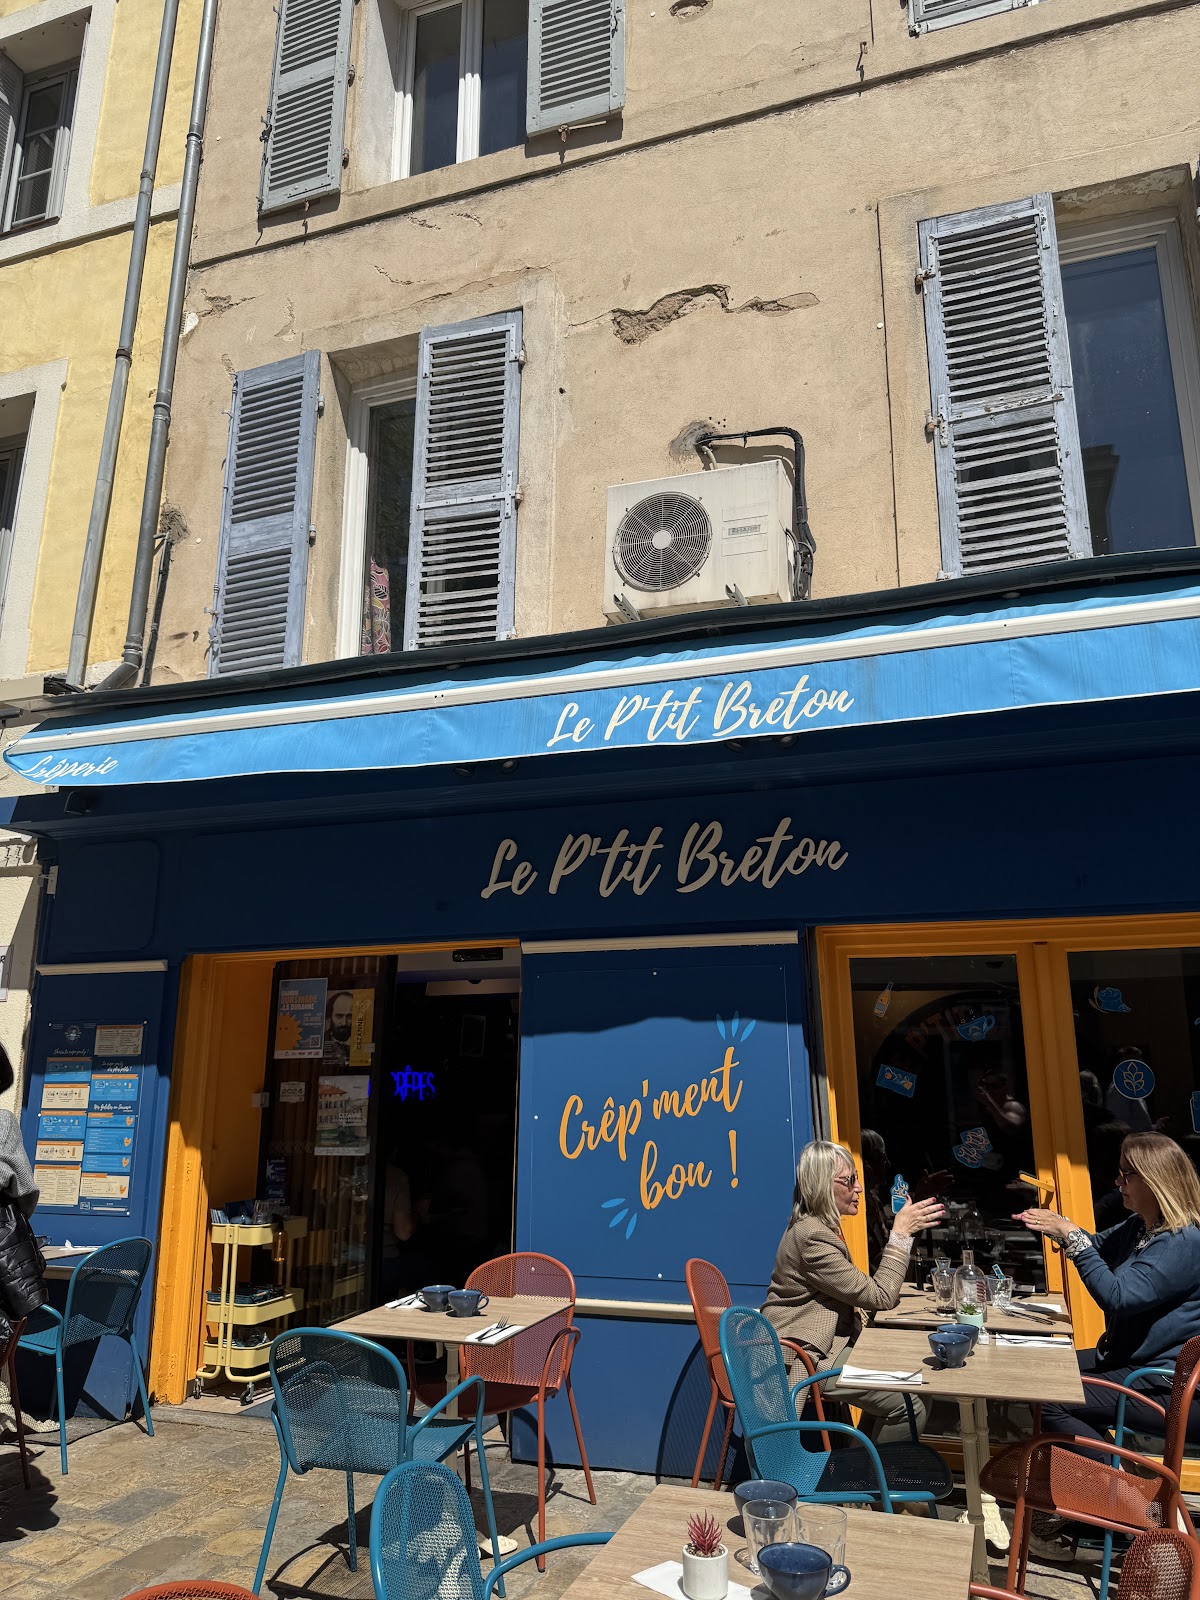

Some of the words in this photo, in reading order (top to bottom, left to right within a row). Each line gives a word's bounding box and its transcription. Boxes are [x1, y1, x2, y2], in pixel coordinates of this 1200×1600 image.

[546, 701, 596, 748] Le
[603, 686, 703, 742] P'tit
[712, 673, 855, 739] Breton
[480, 837, 539, 899] Le
[548, 826, 664, 898] P'tit
[675, 816, 849, 894] Breton
[558, 1046, 744, 1162] Crêp'ment
[639, 1139, 713, 1210] bon
[727, 1129, 740, 1189] !
